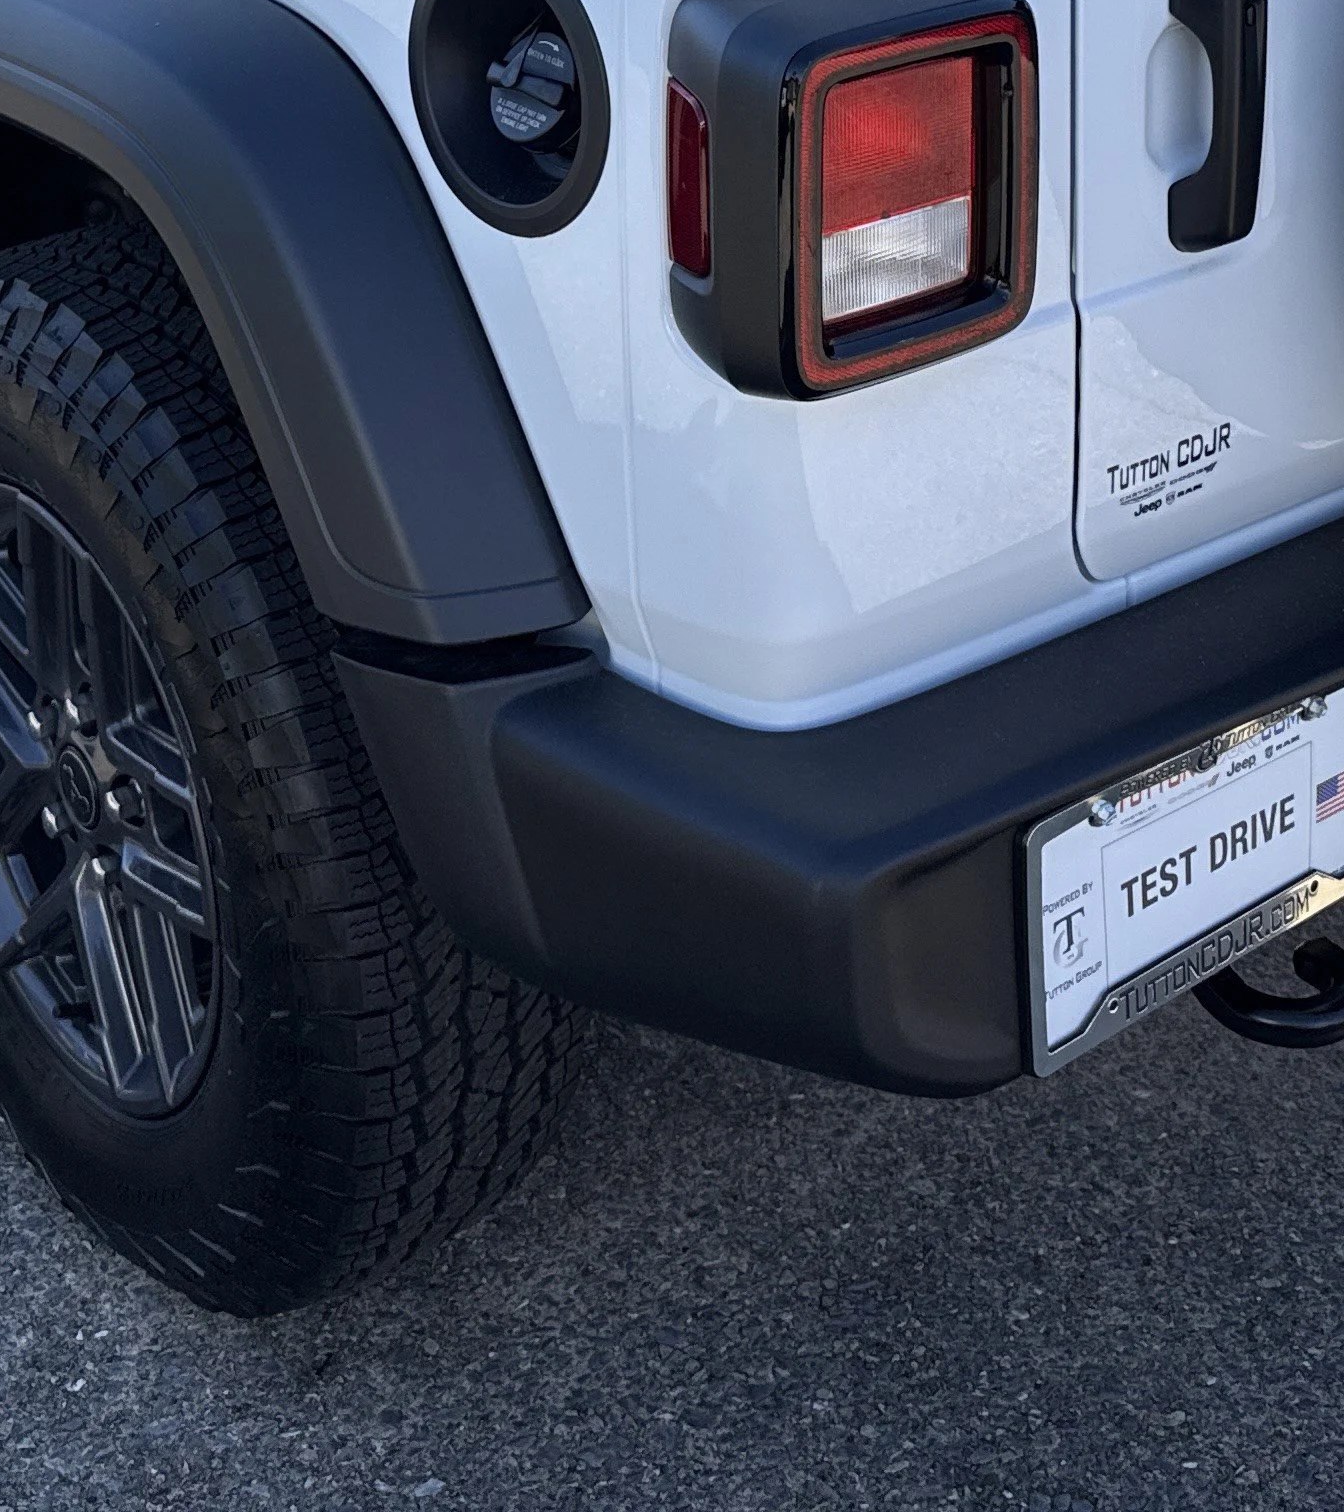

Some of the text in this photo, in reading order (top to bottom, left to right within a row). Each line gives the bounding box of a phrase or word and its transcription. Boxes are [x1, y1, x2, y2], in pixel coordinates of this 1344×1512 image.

[1107, 422, 1231, 494] TUTTON CDJR
[1134, 483, 1203, 517] Jeep RAM
[1226, 755, 1257, 777] Jeep
[1120, 793, 1295, 918] TEST DRIVE
[1042, 881, 1094, 917] POWERED BY
[1120, 885, 1310, 1022] TUTTONCDJR.COM
[1075, 960, 1103, 984] GROUP
